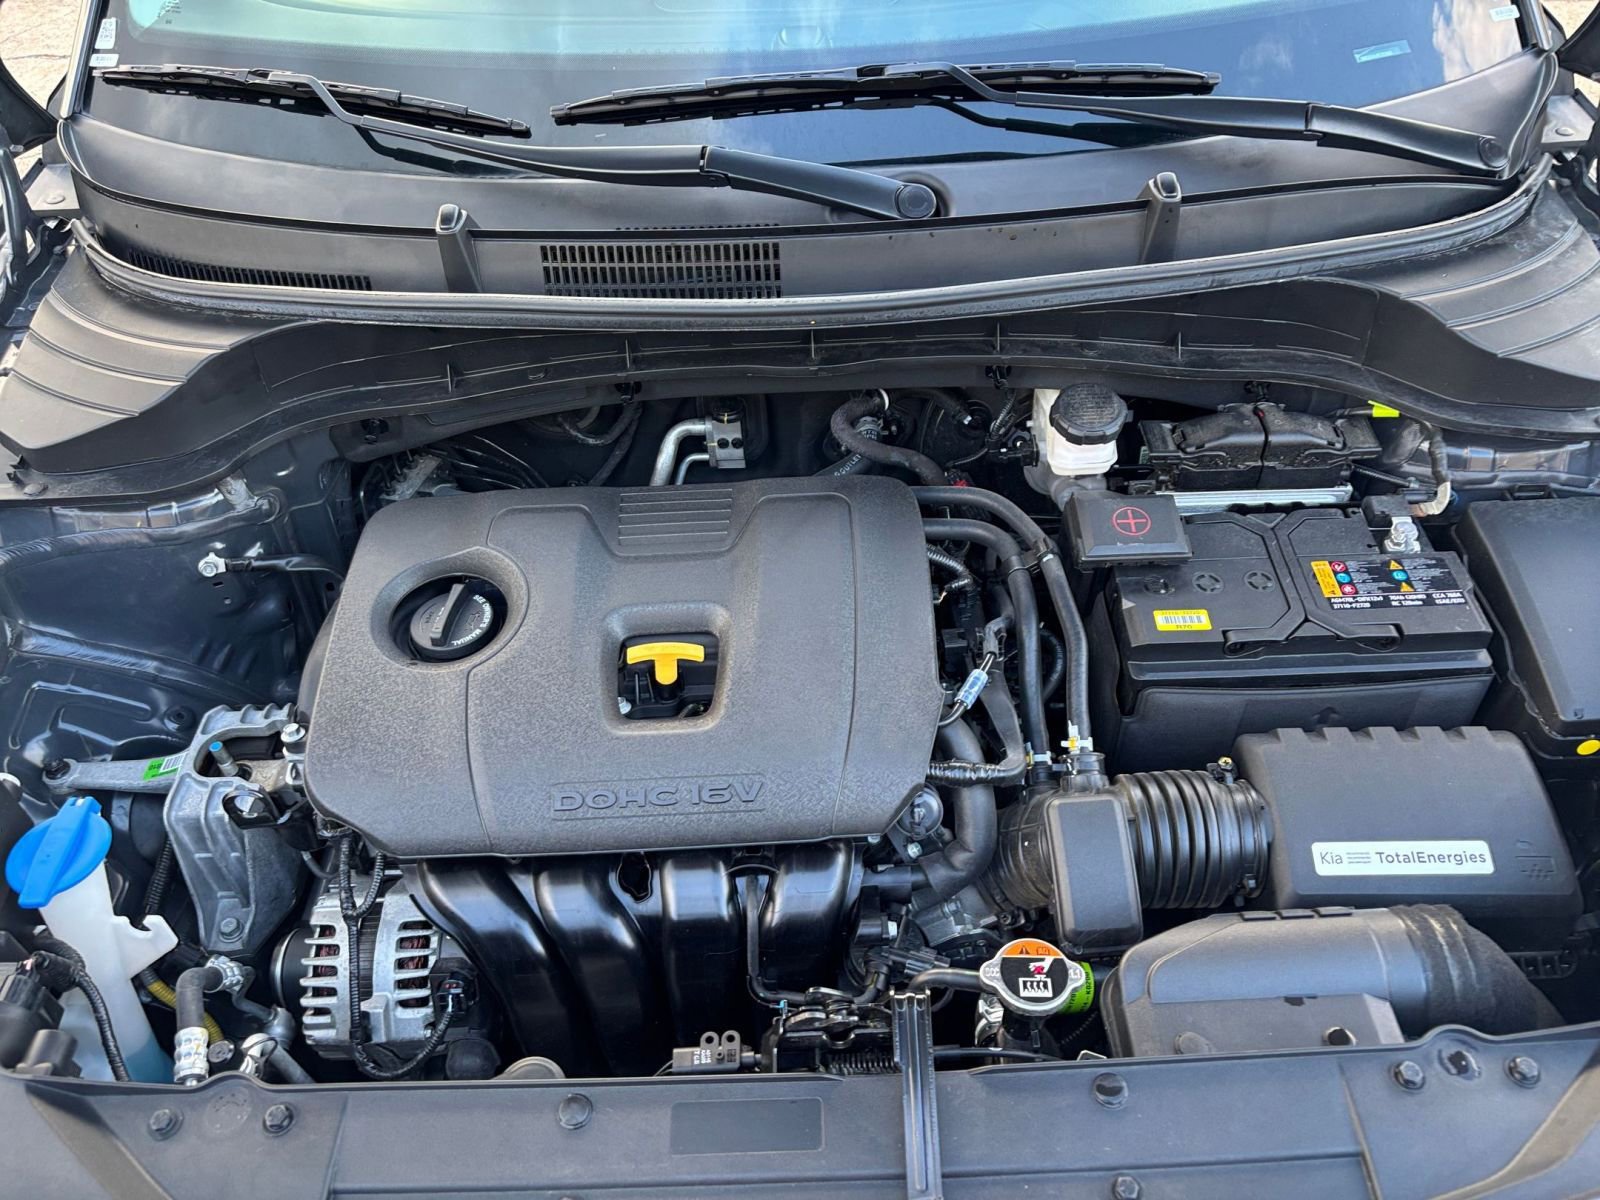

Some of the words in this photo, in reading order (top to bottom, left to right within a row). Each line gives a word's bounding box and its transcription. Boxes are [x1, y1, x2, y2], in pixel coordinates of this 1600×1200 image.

[553, 786, 679, 811] DOHC
[690, 782, 764, 806] 16V
[1320, 851, 1343, 864] Kia
[1375, 851, 1487, 865] TotalEnergies
